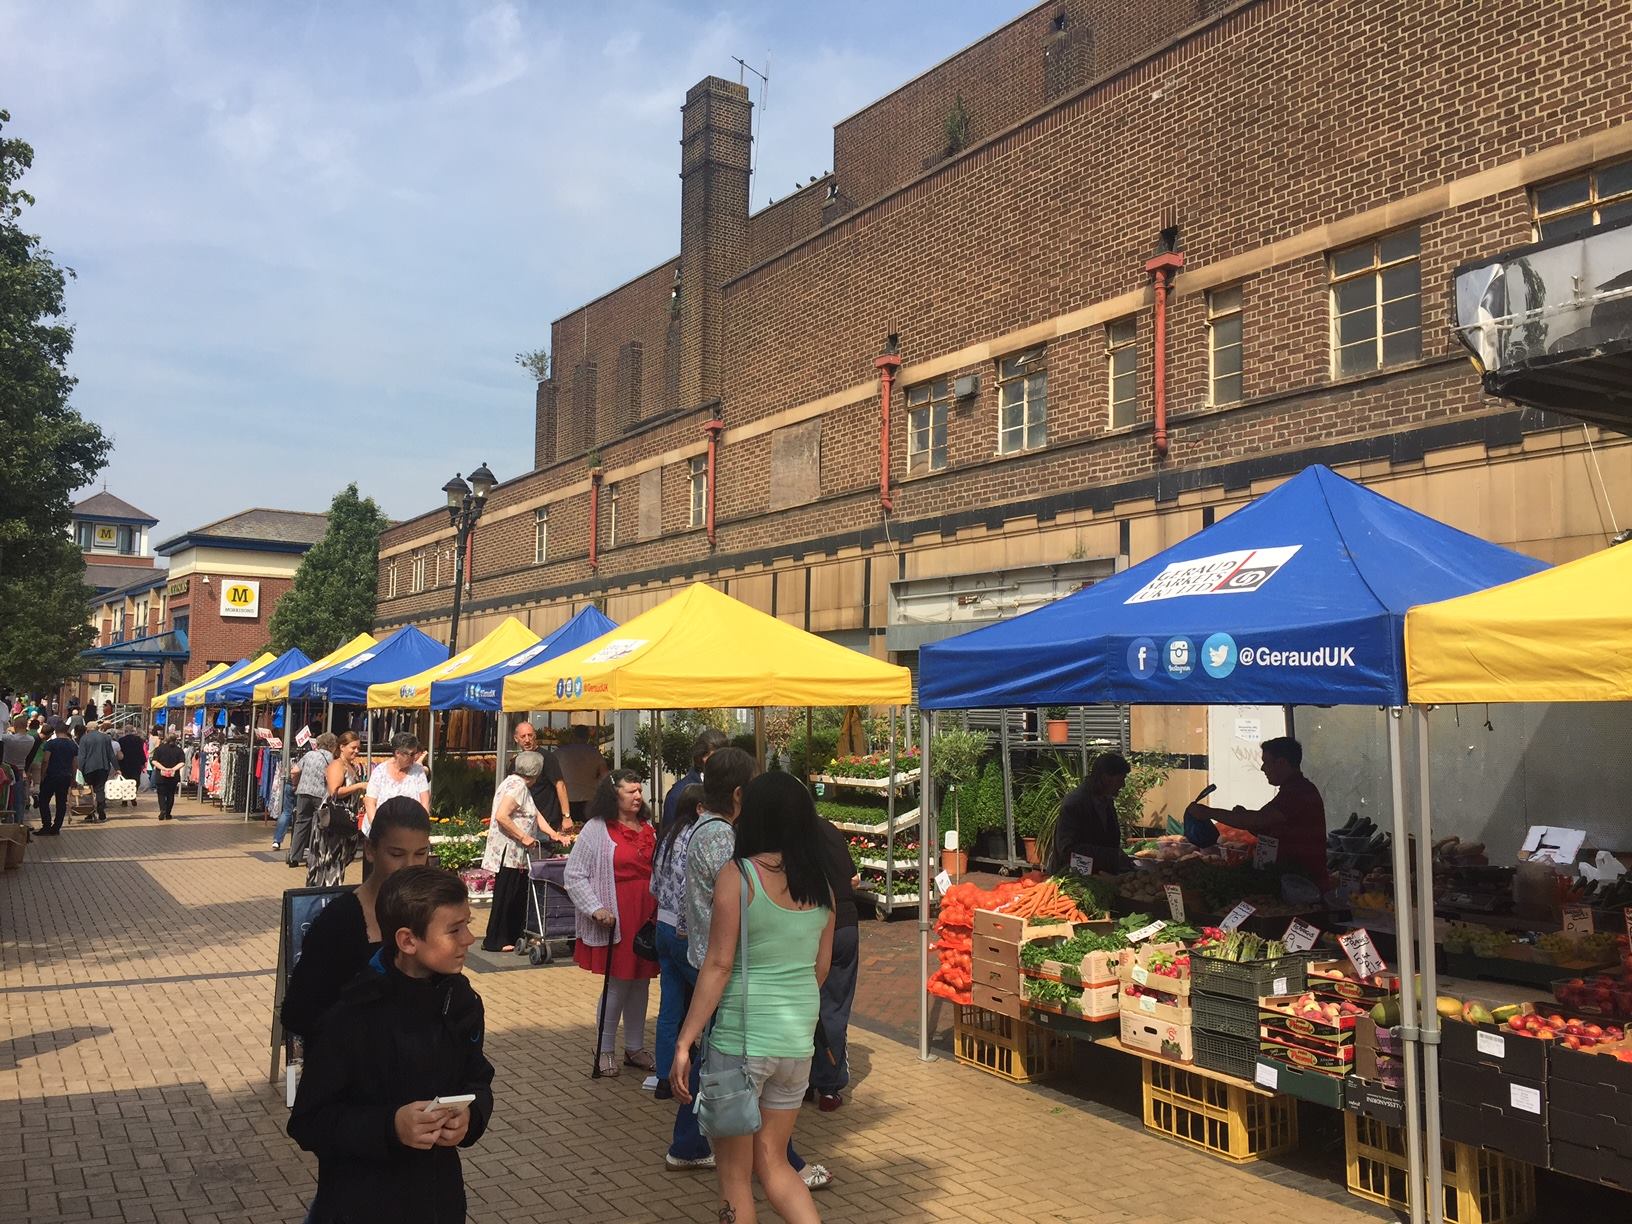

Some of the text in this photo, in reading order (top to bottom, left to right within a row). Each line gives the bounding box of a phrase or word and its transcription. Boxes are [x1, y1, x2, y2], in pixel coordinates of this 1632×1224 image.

[101, 529, 112, 539] M
[1157, 561, 1237, 581] GERAUD
[1148, 572, 1226, 590] MARKETS
[1176, 582, 1213, 595] LTD
[231, 588, 249, 603] M
[1239, 647, 1355, 668] @GeraudUK
